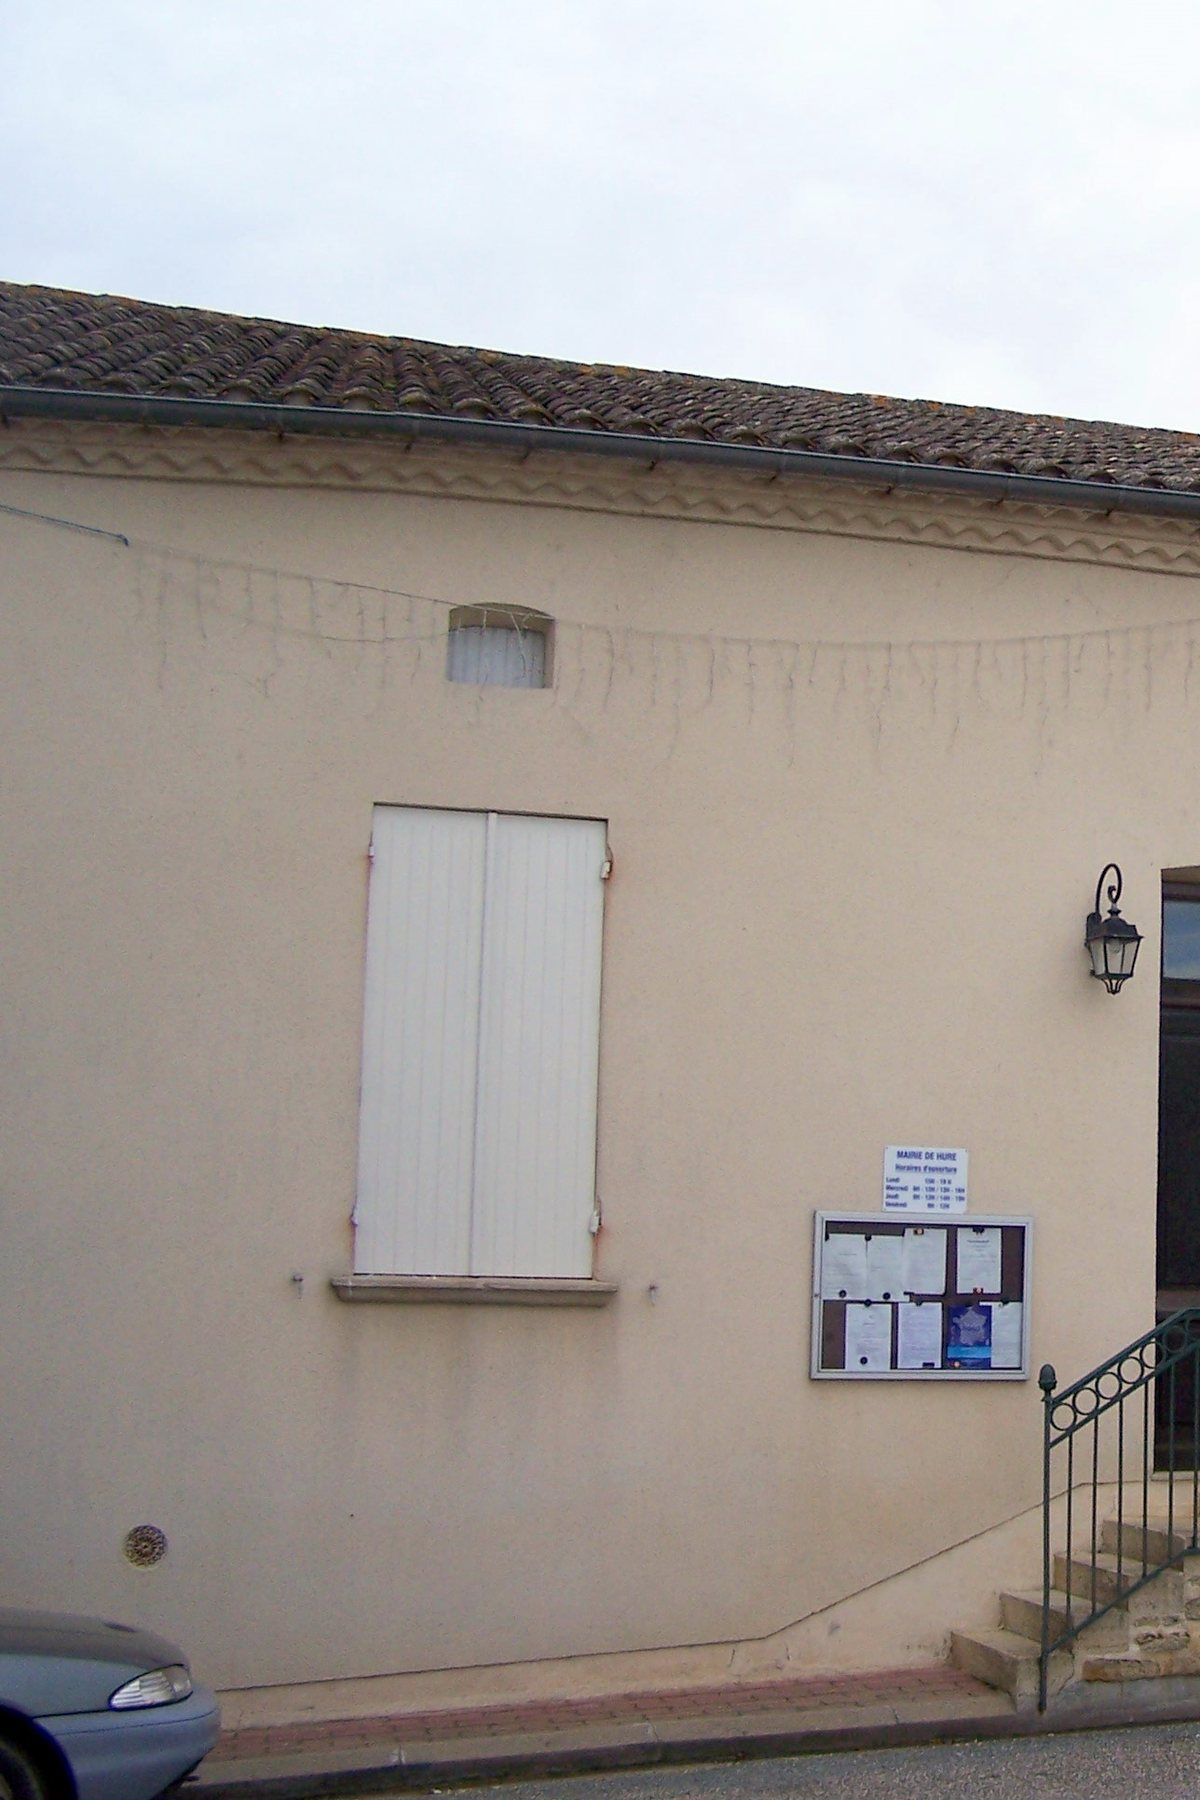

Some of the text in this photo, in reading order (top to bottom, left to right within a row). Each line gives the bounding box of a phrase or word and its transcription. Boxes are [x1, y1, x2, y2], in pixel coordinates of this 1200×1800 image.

[896, 1150, 957, 1161] MAIRIE DE HURE
[895, 1163, 921, 1173] Horaires
